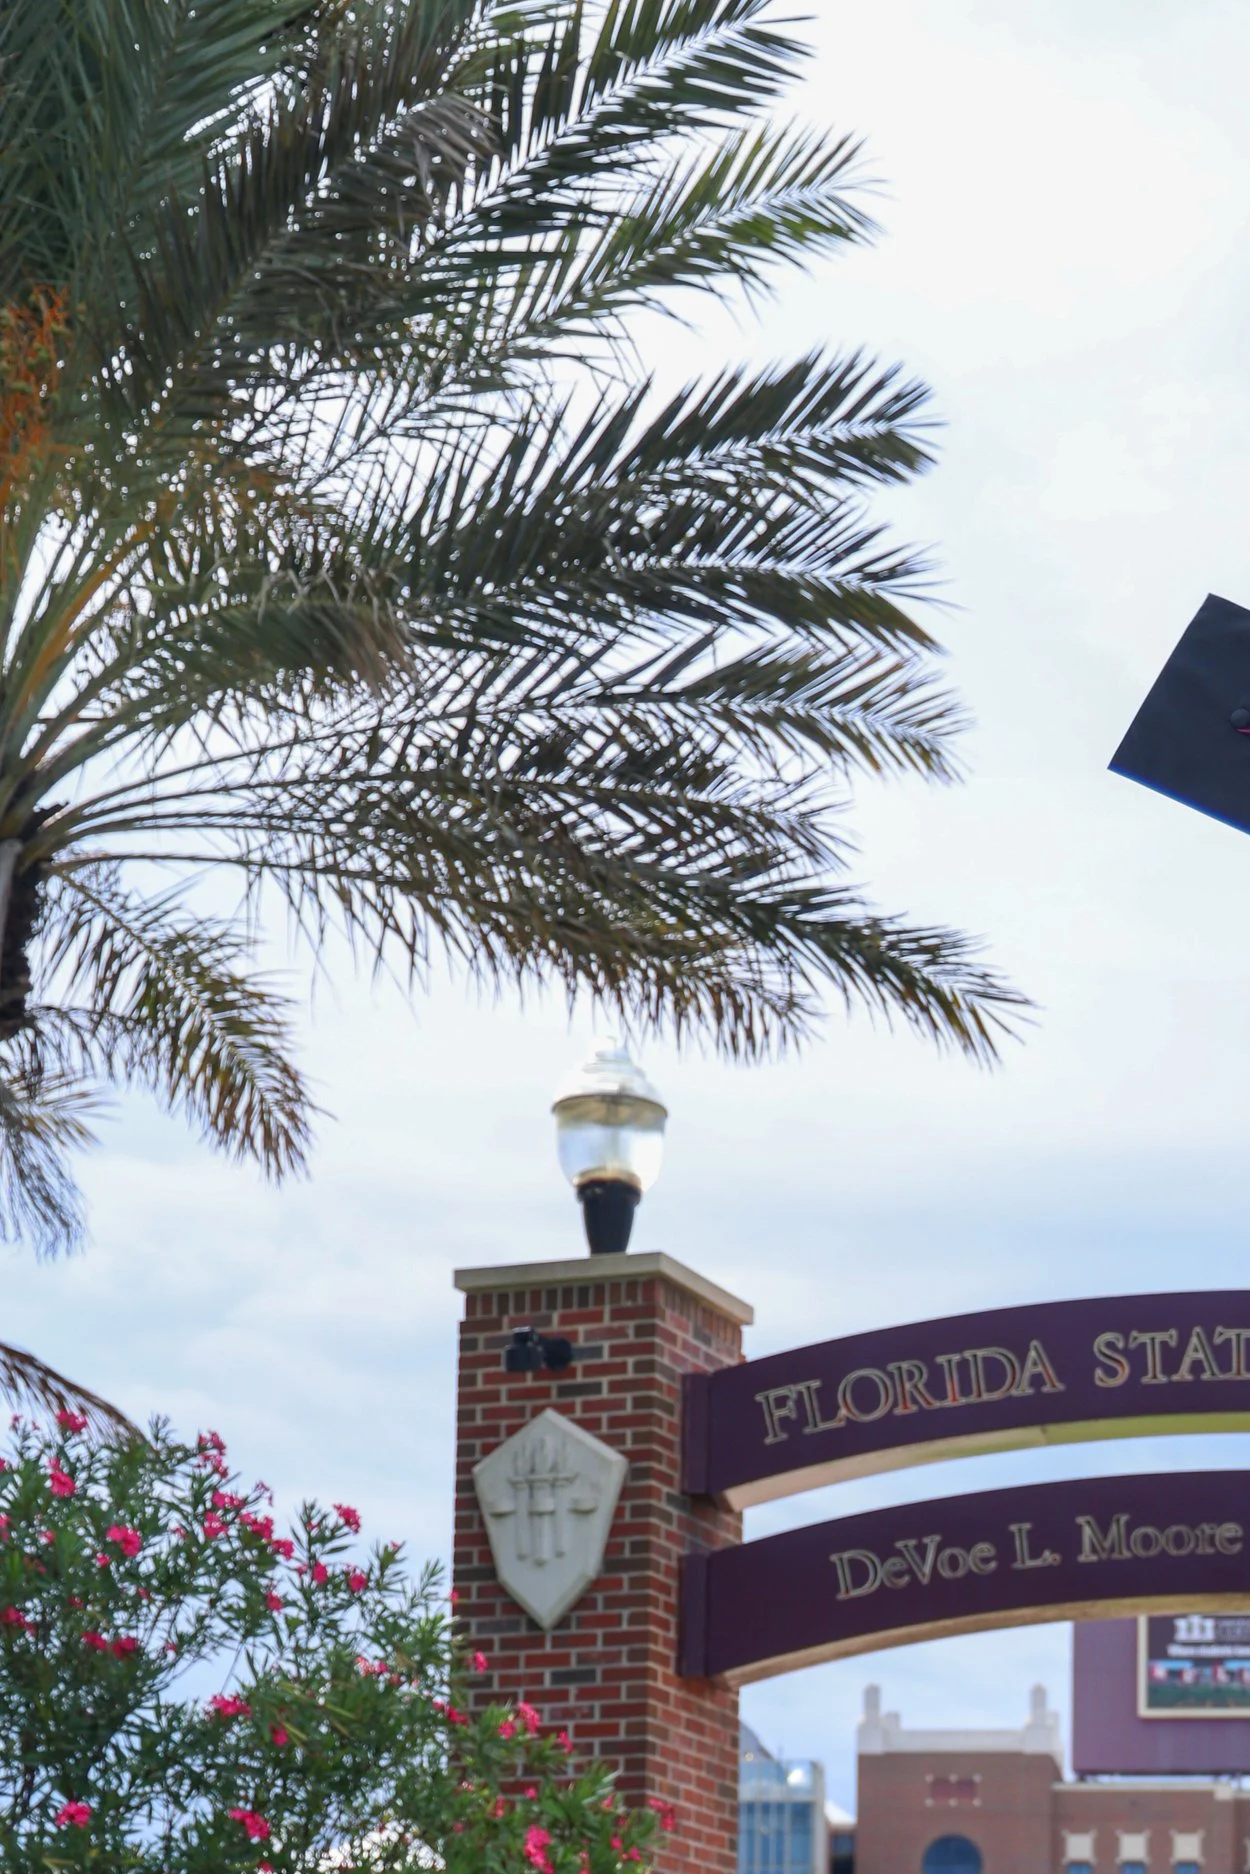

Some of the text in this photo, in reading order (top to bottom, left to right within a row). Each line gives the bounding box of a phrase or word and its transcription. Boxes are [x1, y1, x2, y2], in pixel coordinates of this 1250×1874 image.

[756, 1340, 1064, 1444] FLORIDA
[829, 1535, 997, 1600] DeVoe
[1009, 1523, 1062, 1569] L.
[1076, 1513, 1243, 1563] Moore
